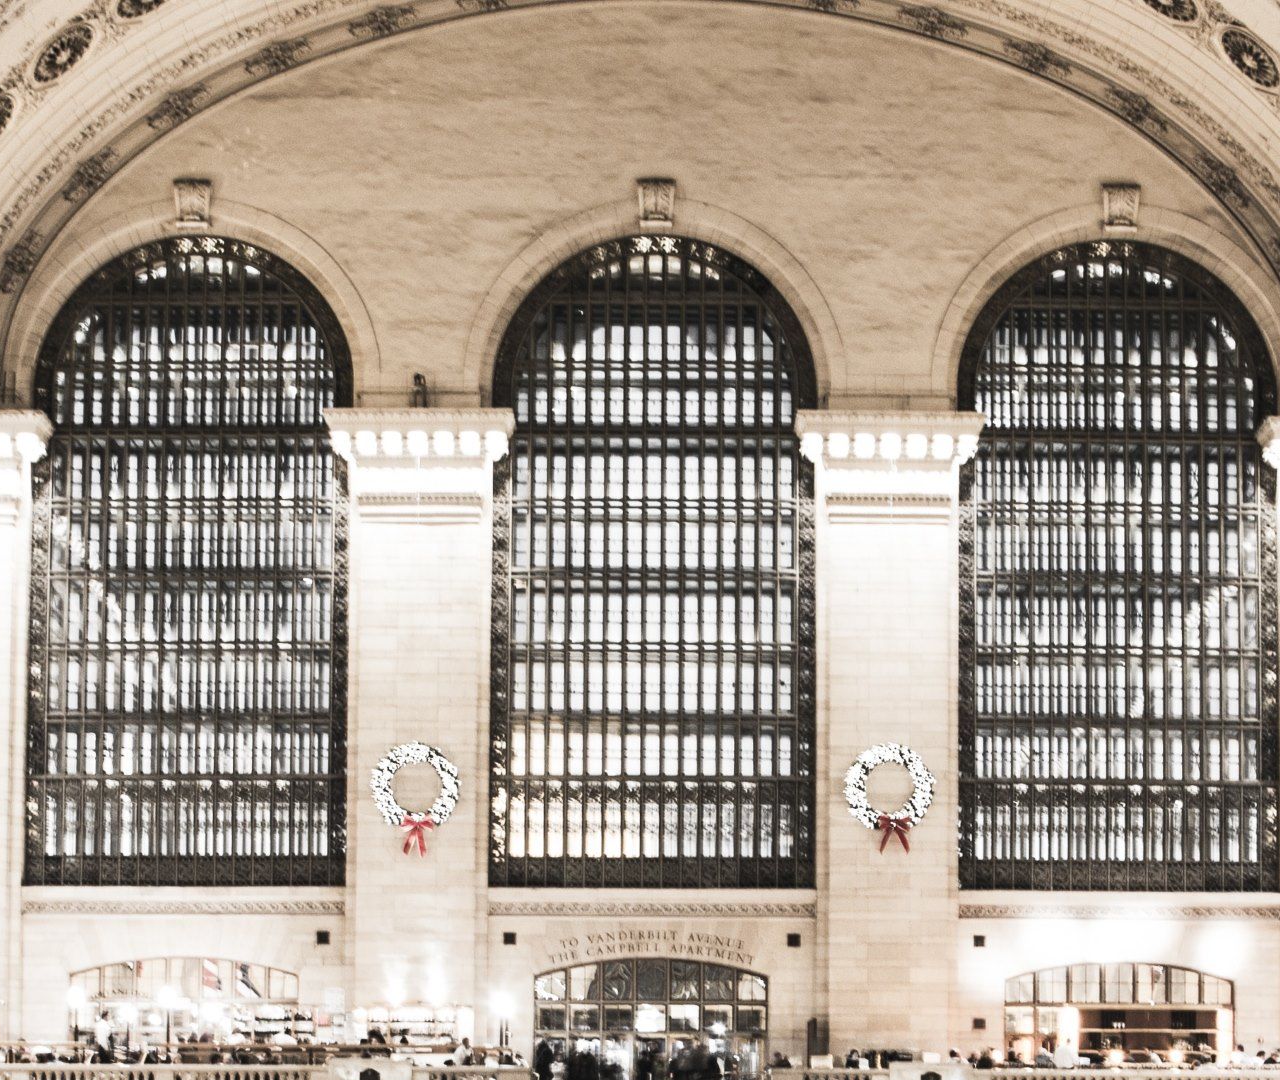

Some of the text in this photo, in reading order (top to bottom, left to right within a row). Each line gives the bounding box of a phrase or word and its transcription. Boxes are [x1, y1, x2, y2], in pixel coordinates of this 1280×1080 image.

[560, 929, 745, 950] TO VANDERBILT AVENUE
[549, 941, 755, 965] THE CAMPBELL APARTMENT
